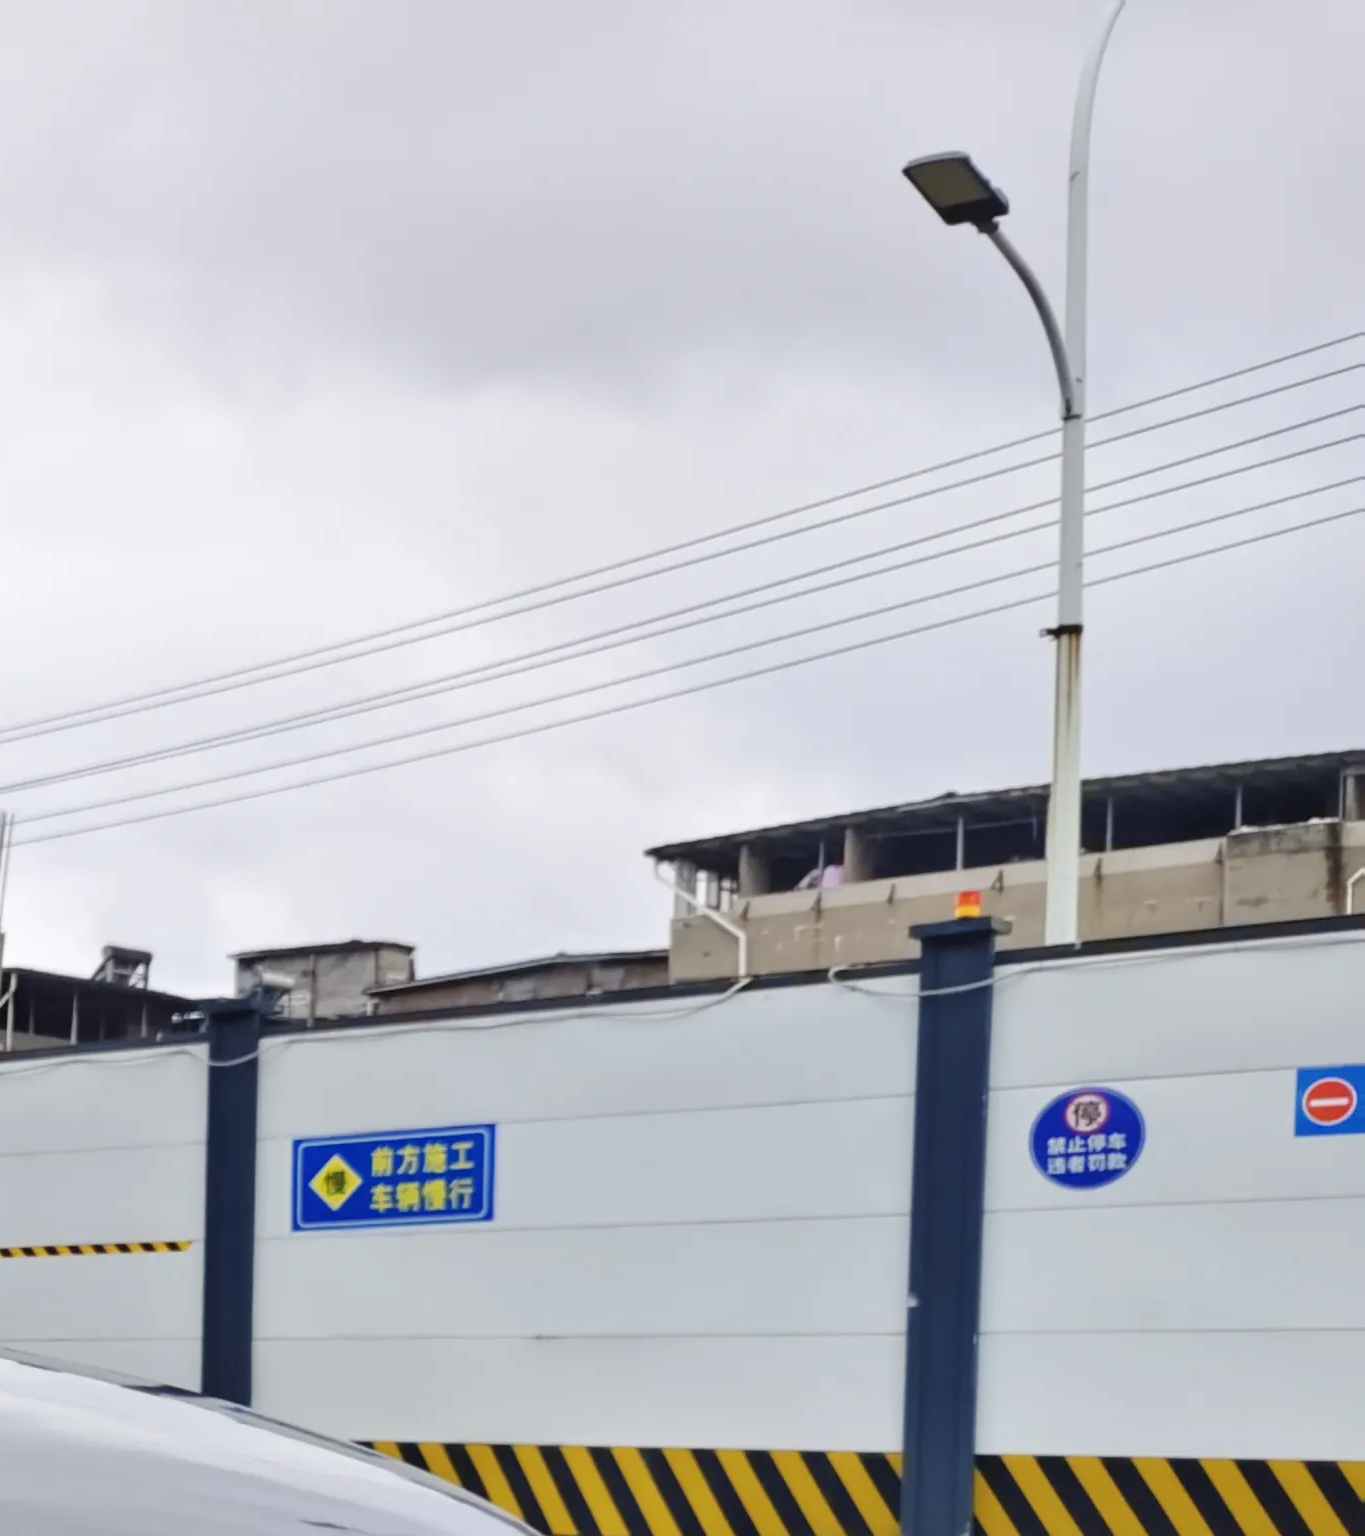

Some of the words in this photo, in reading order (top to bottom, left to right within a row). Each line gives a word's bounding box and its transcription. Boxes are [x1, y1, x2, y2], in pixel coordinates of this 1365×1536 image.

[370, 1141, 475, 1177] 前方施工
[369, 1177, 474, 1213] 车辆慢行
